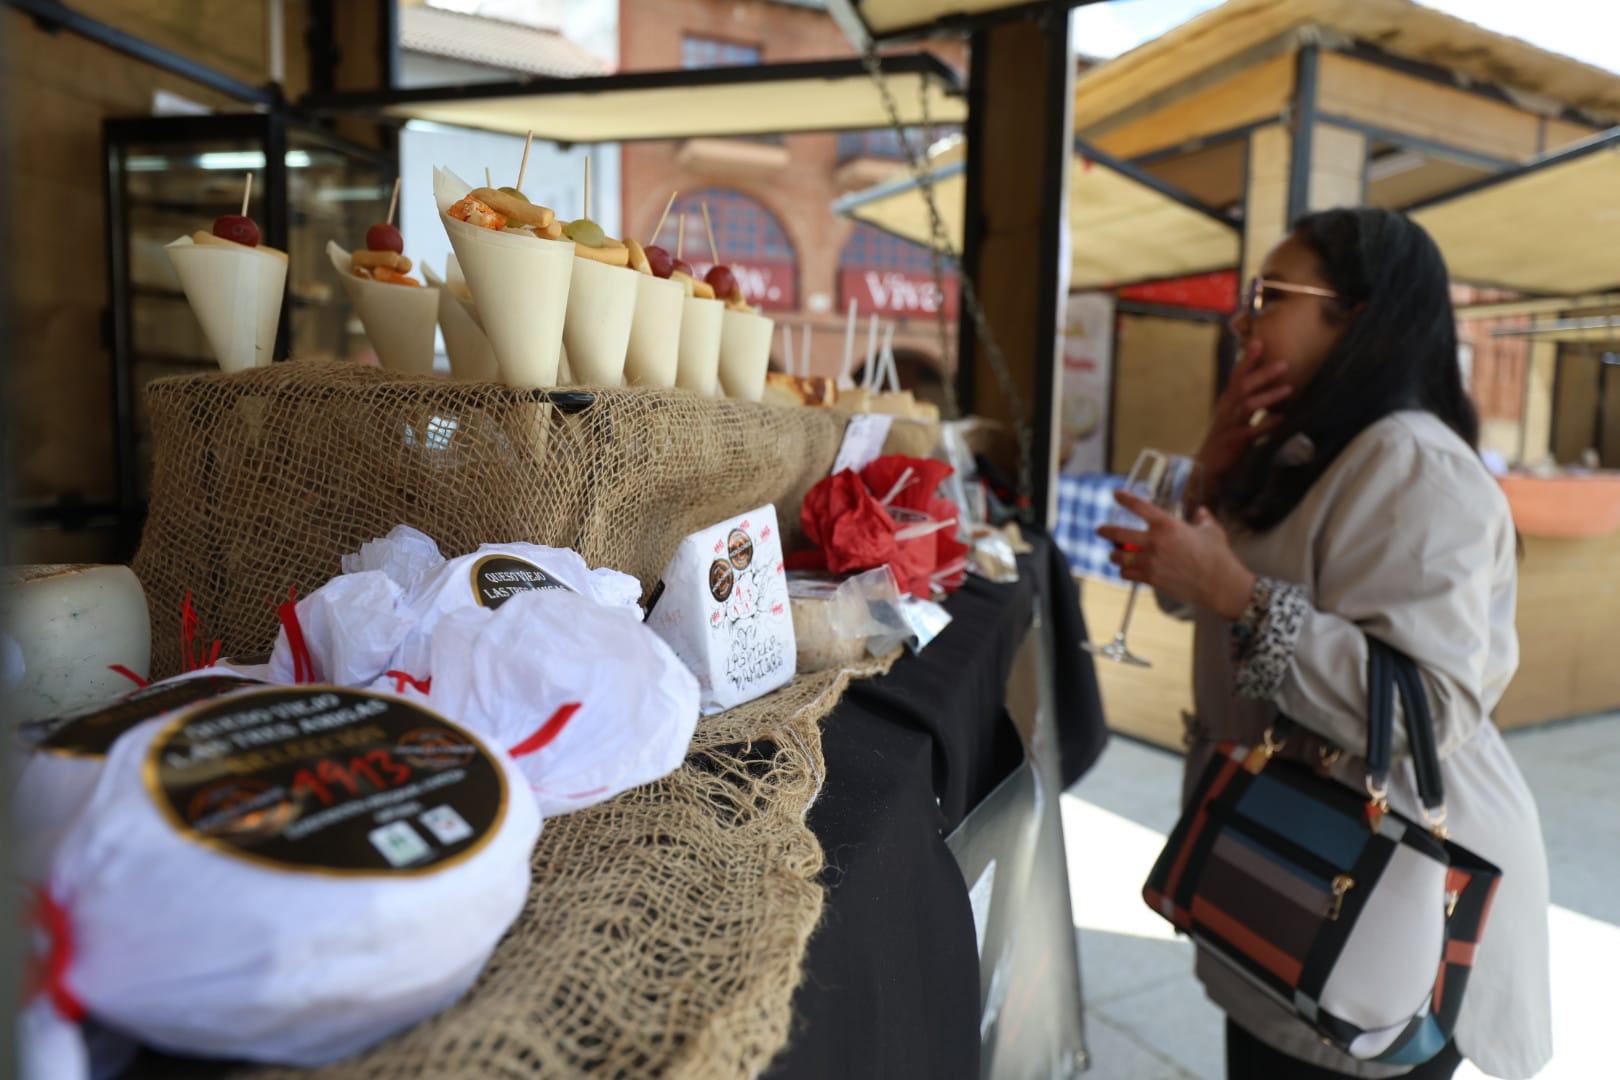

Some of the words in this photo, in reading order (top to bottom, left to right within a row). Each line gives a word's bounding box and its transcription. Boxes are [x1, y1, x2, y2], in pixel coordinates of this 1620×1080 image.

[483, 586, 509, 599] LAS
[484, 570, 518, 583] QUESO
[516, 570, 546, 582] VIEJO
[183, 708, 272, 740] QUESO
[270, 693, 340, 719] VIEJO
[231, 723, 299, 748] TRES
[299, 699, 388, 733] AMIGAS
[291, 750, 412, 806] 1913
